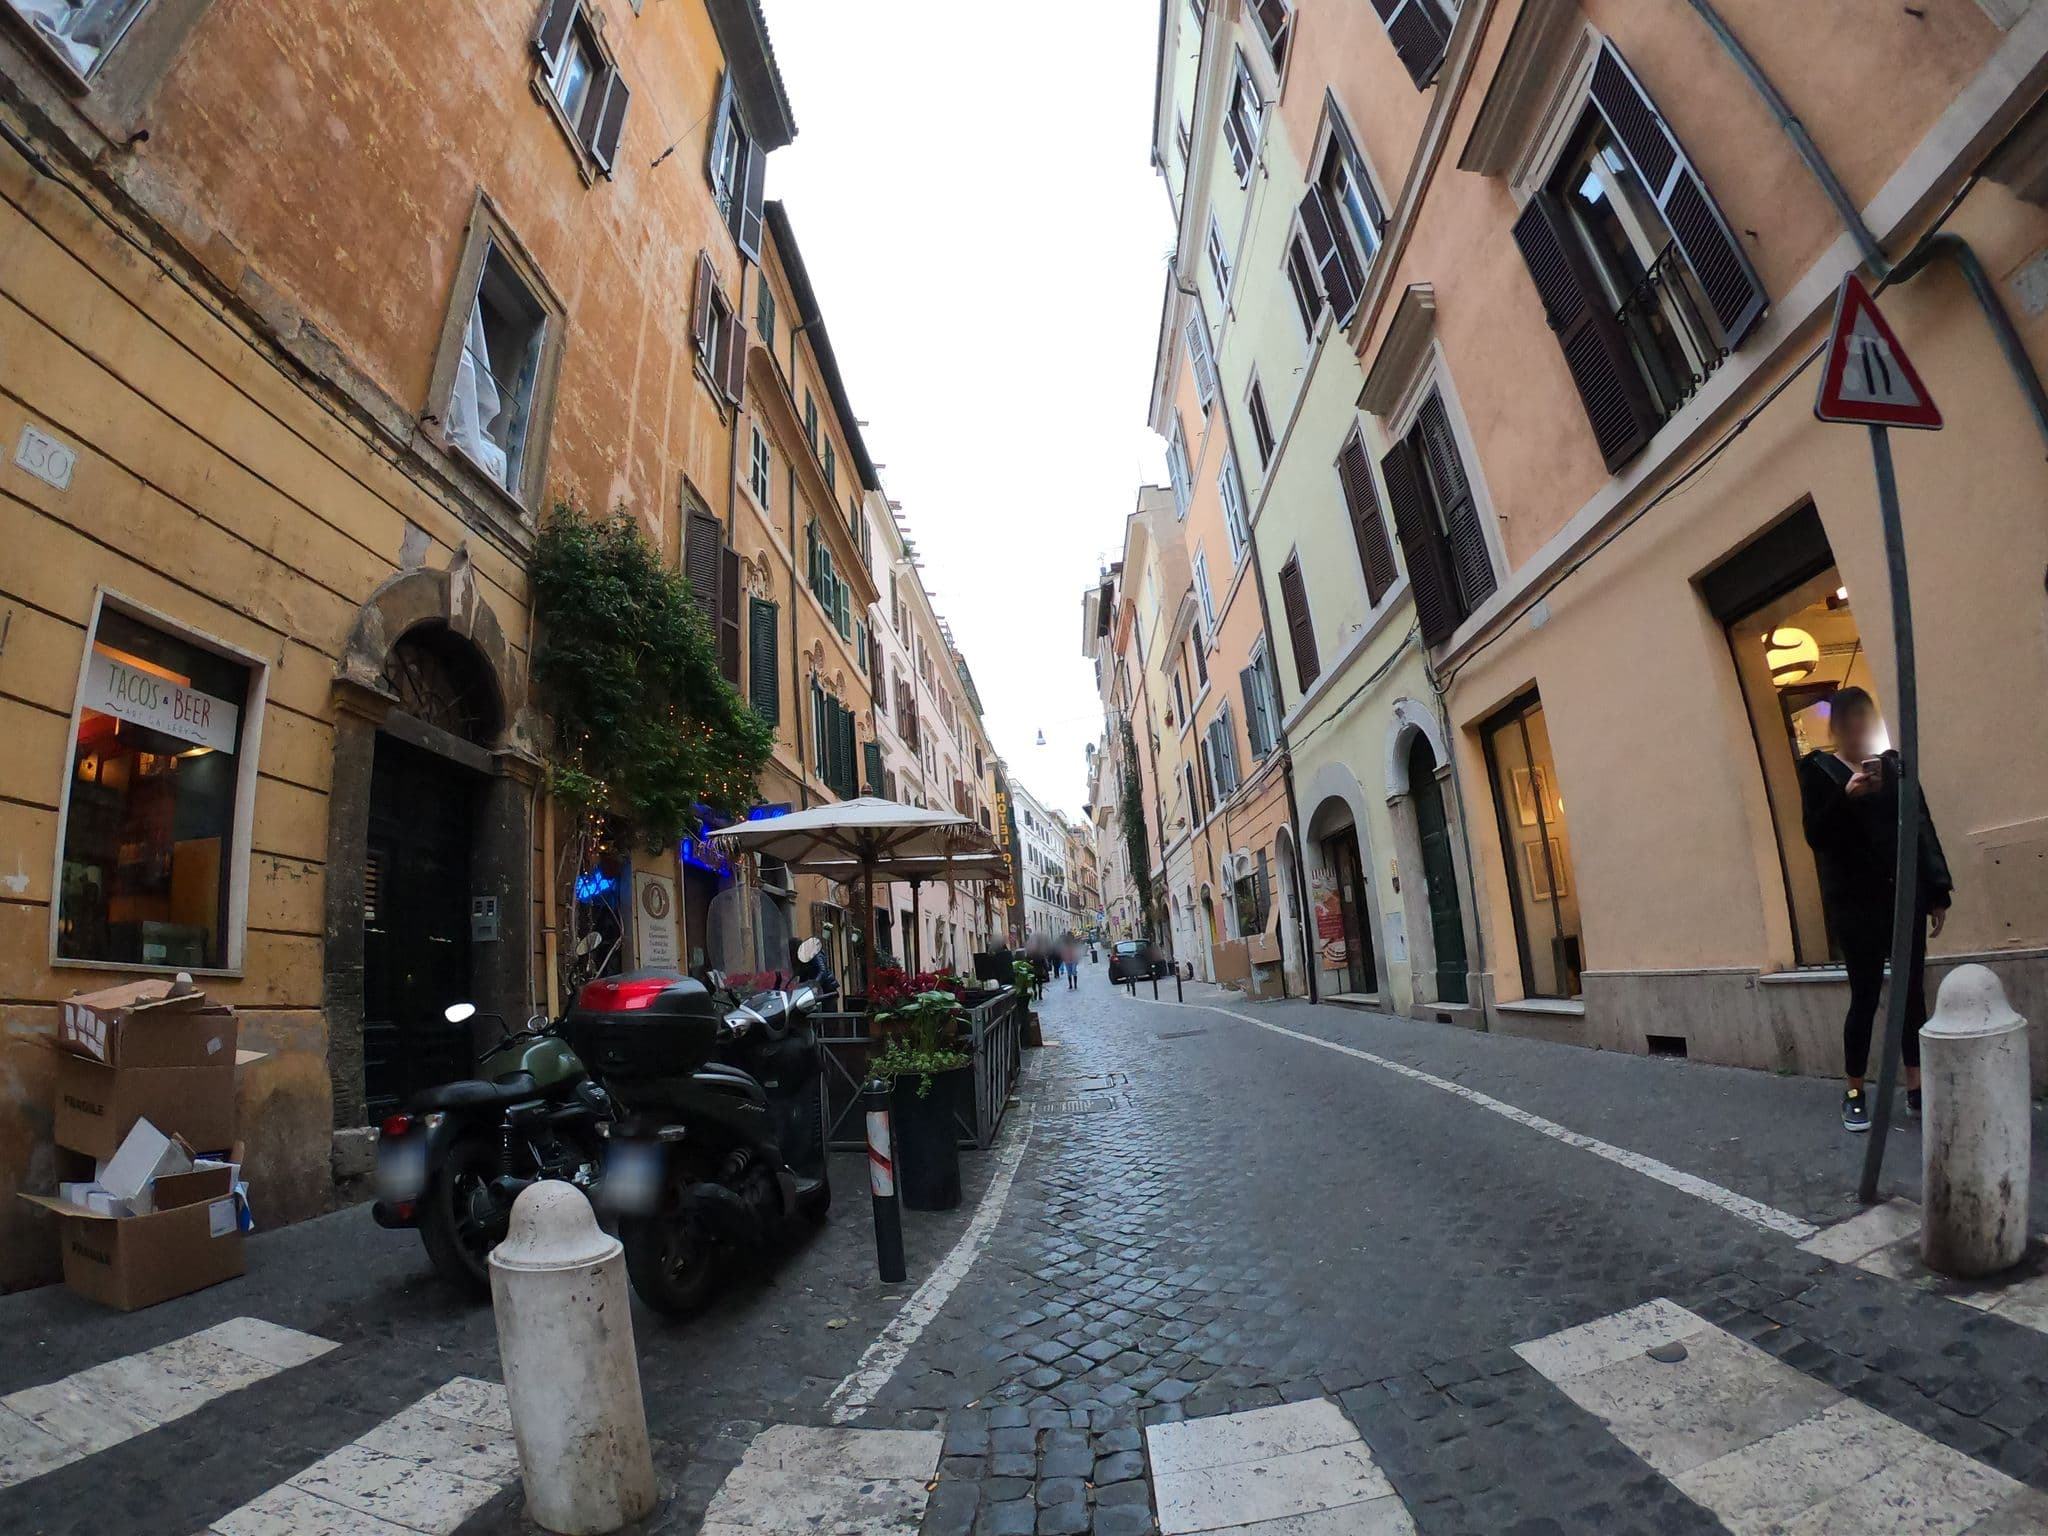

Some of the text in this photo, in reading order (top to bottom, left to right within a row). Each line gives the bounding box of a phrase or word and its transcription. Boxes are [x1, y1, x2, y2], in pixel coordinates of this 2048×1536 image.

[20, 432, 68, 480] 130
[109, 663, 161, 711] TACOS
[173, 688, 211, 728] BEER
